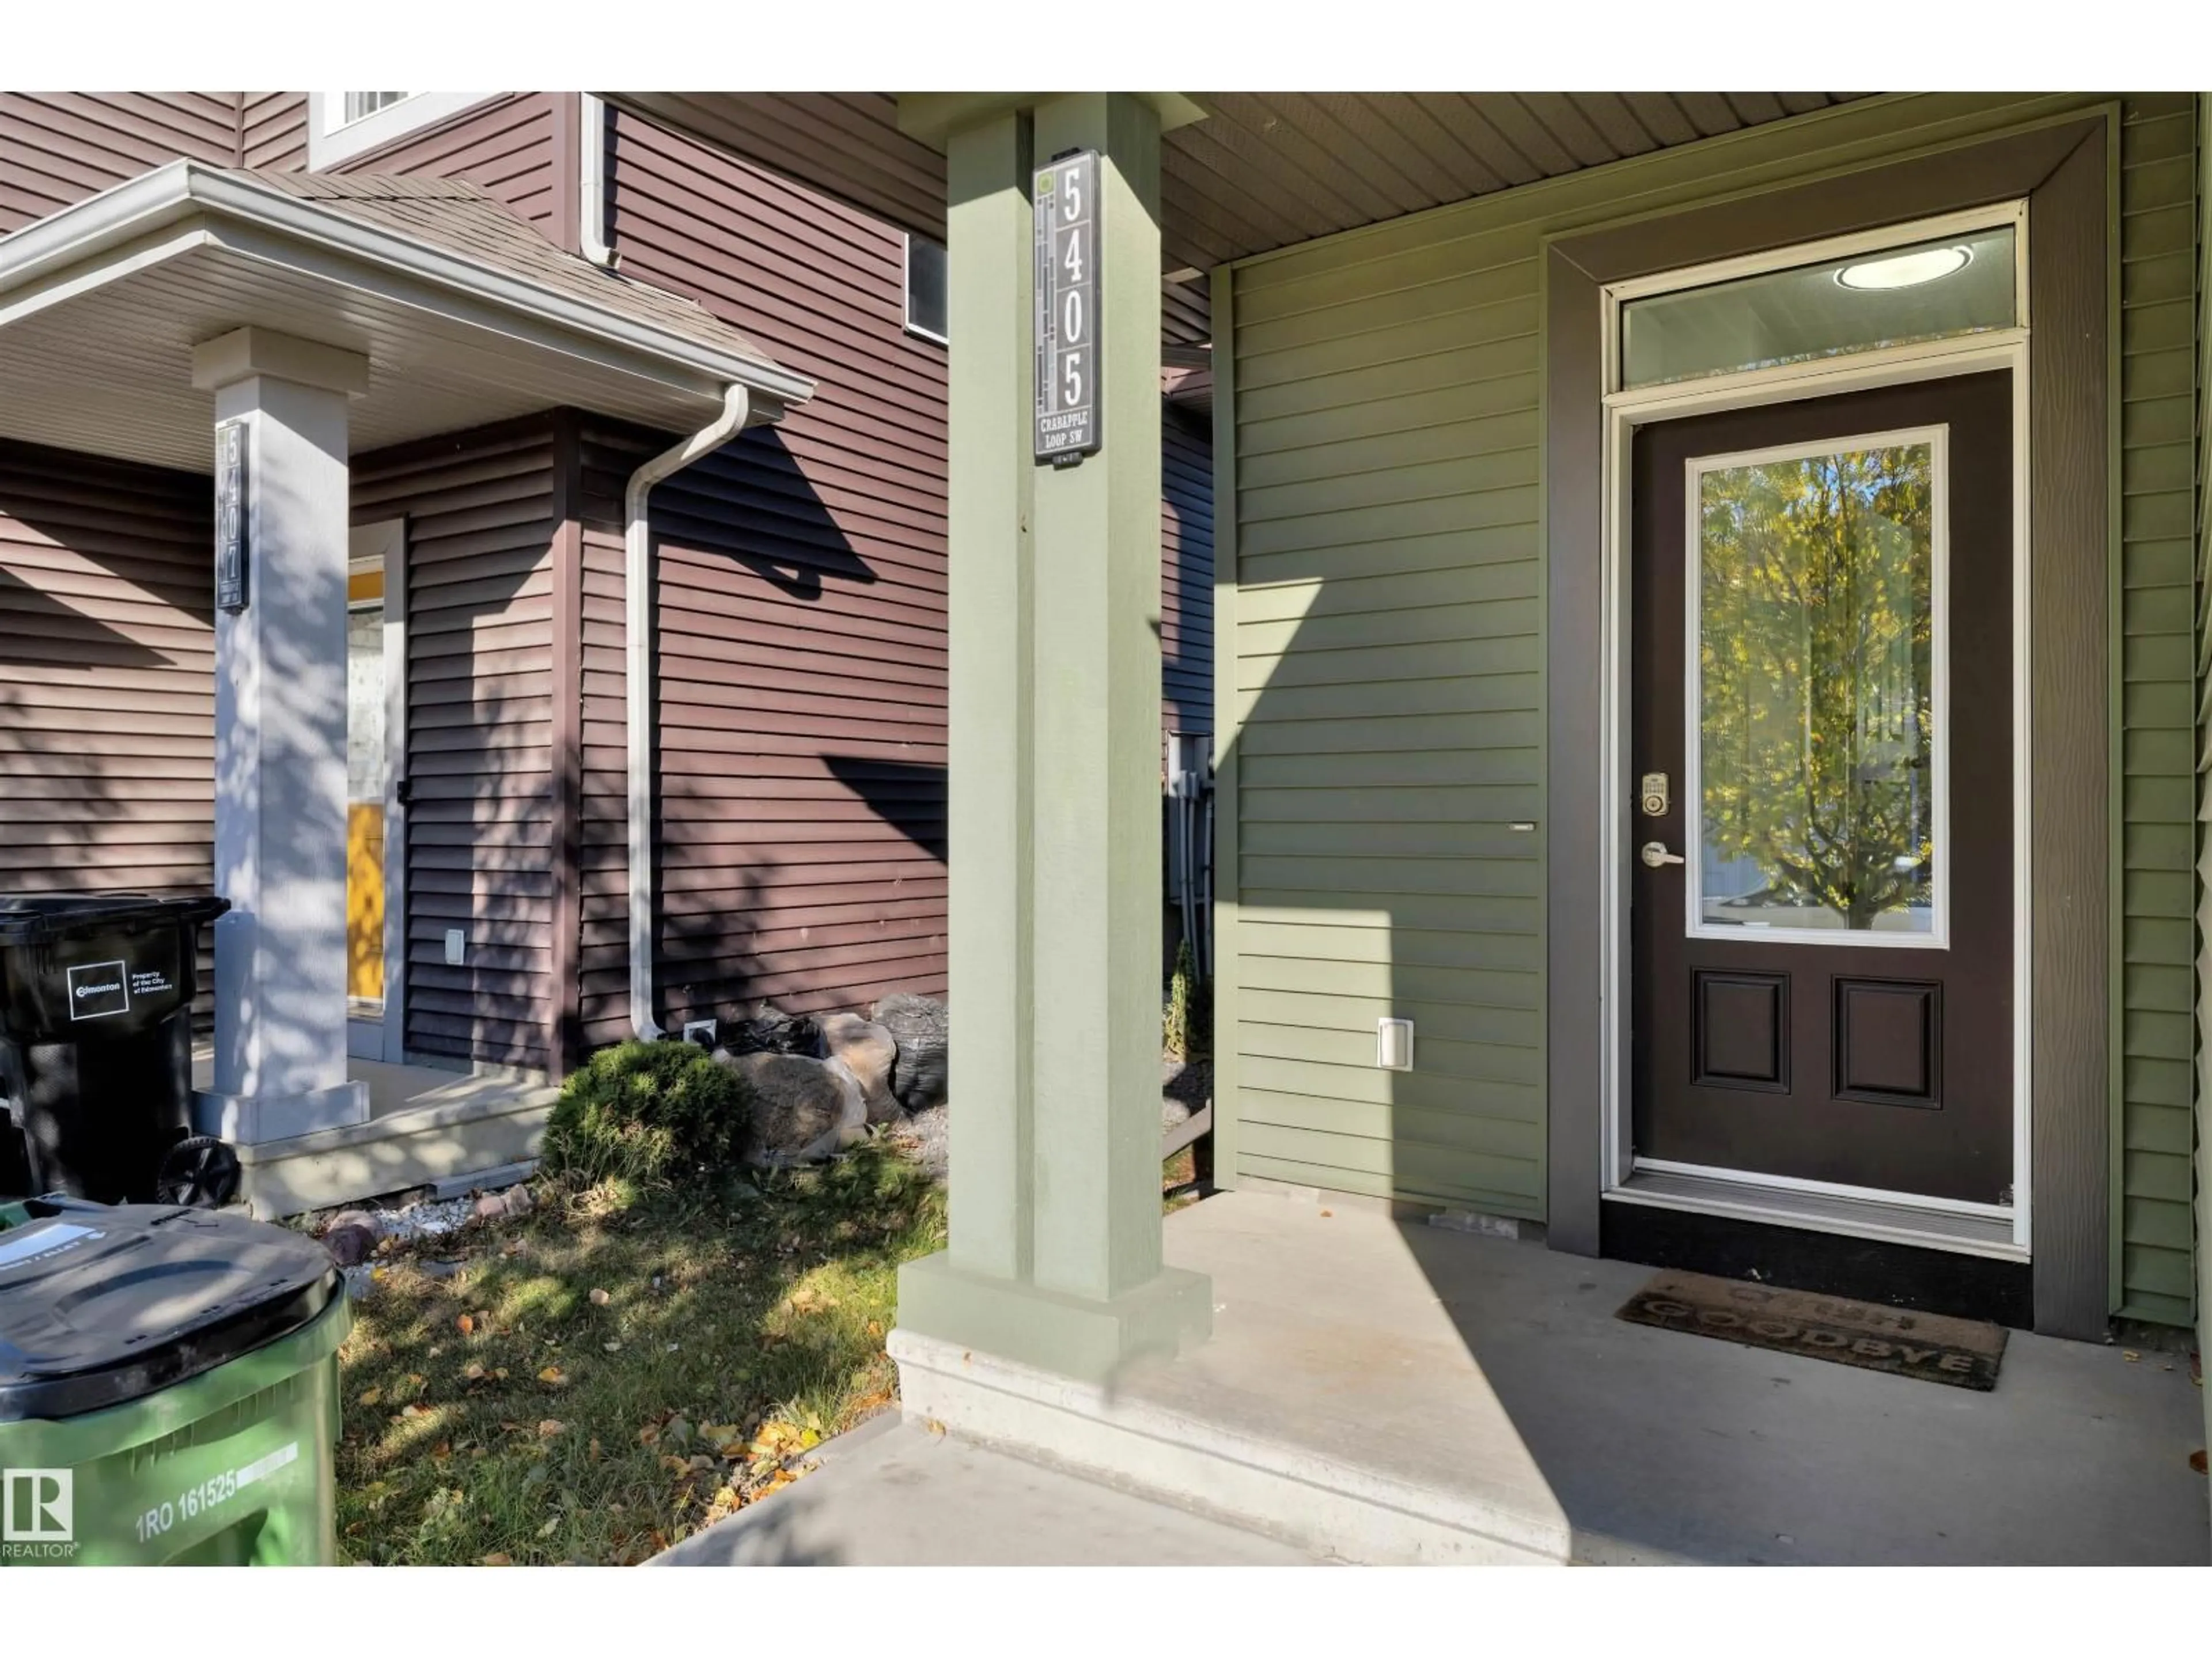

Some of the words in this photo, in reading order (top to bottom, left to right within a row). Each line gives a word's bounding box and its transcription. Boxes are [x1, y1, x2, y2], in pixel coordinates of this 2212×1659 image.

[1064, 167, 1082, 406] 5405
[1041, 411, 1088, 432] CRABAPPLE
[1046, 433, 1067, 449] LOOP
[1070, 429, 1082, 444] SW
[229, 433, 237, 579] 5407
[132, 972, 160, 980] Property
[151, 978, 165, 986] City
[75, 982, 120, 998] Edmonton
[142, 984, 172, 994] Edmonton
[1645, 1301, 1974, 1373] GOODBYE
[135, 1501, 174, 1543] 1RO
[177, 1469, 237, 1522] 161525
